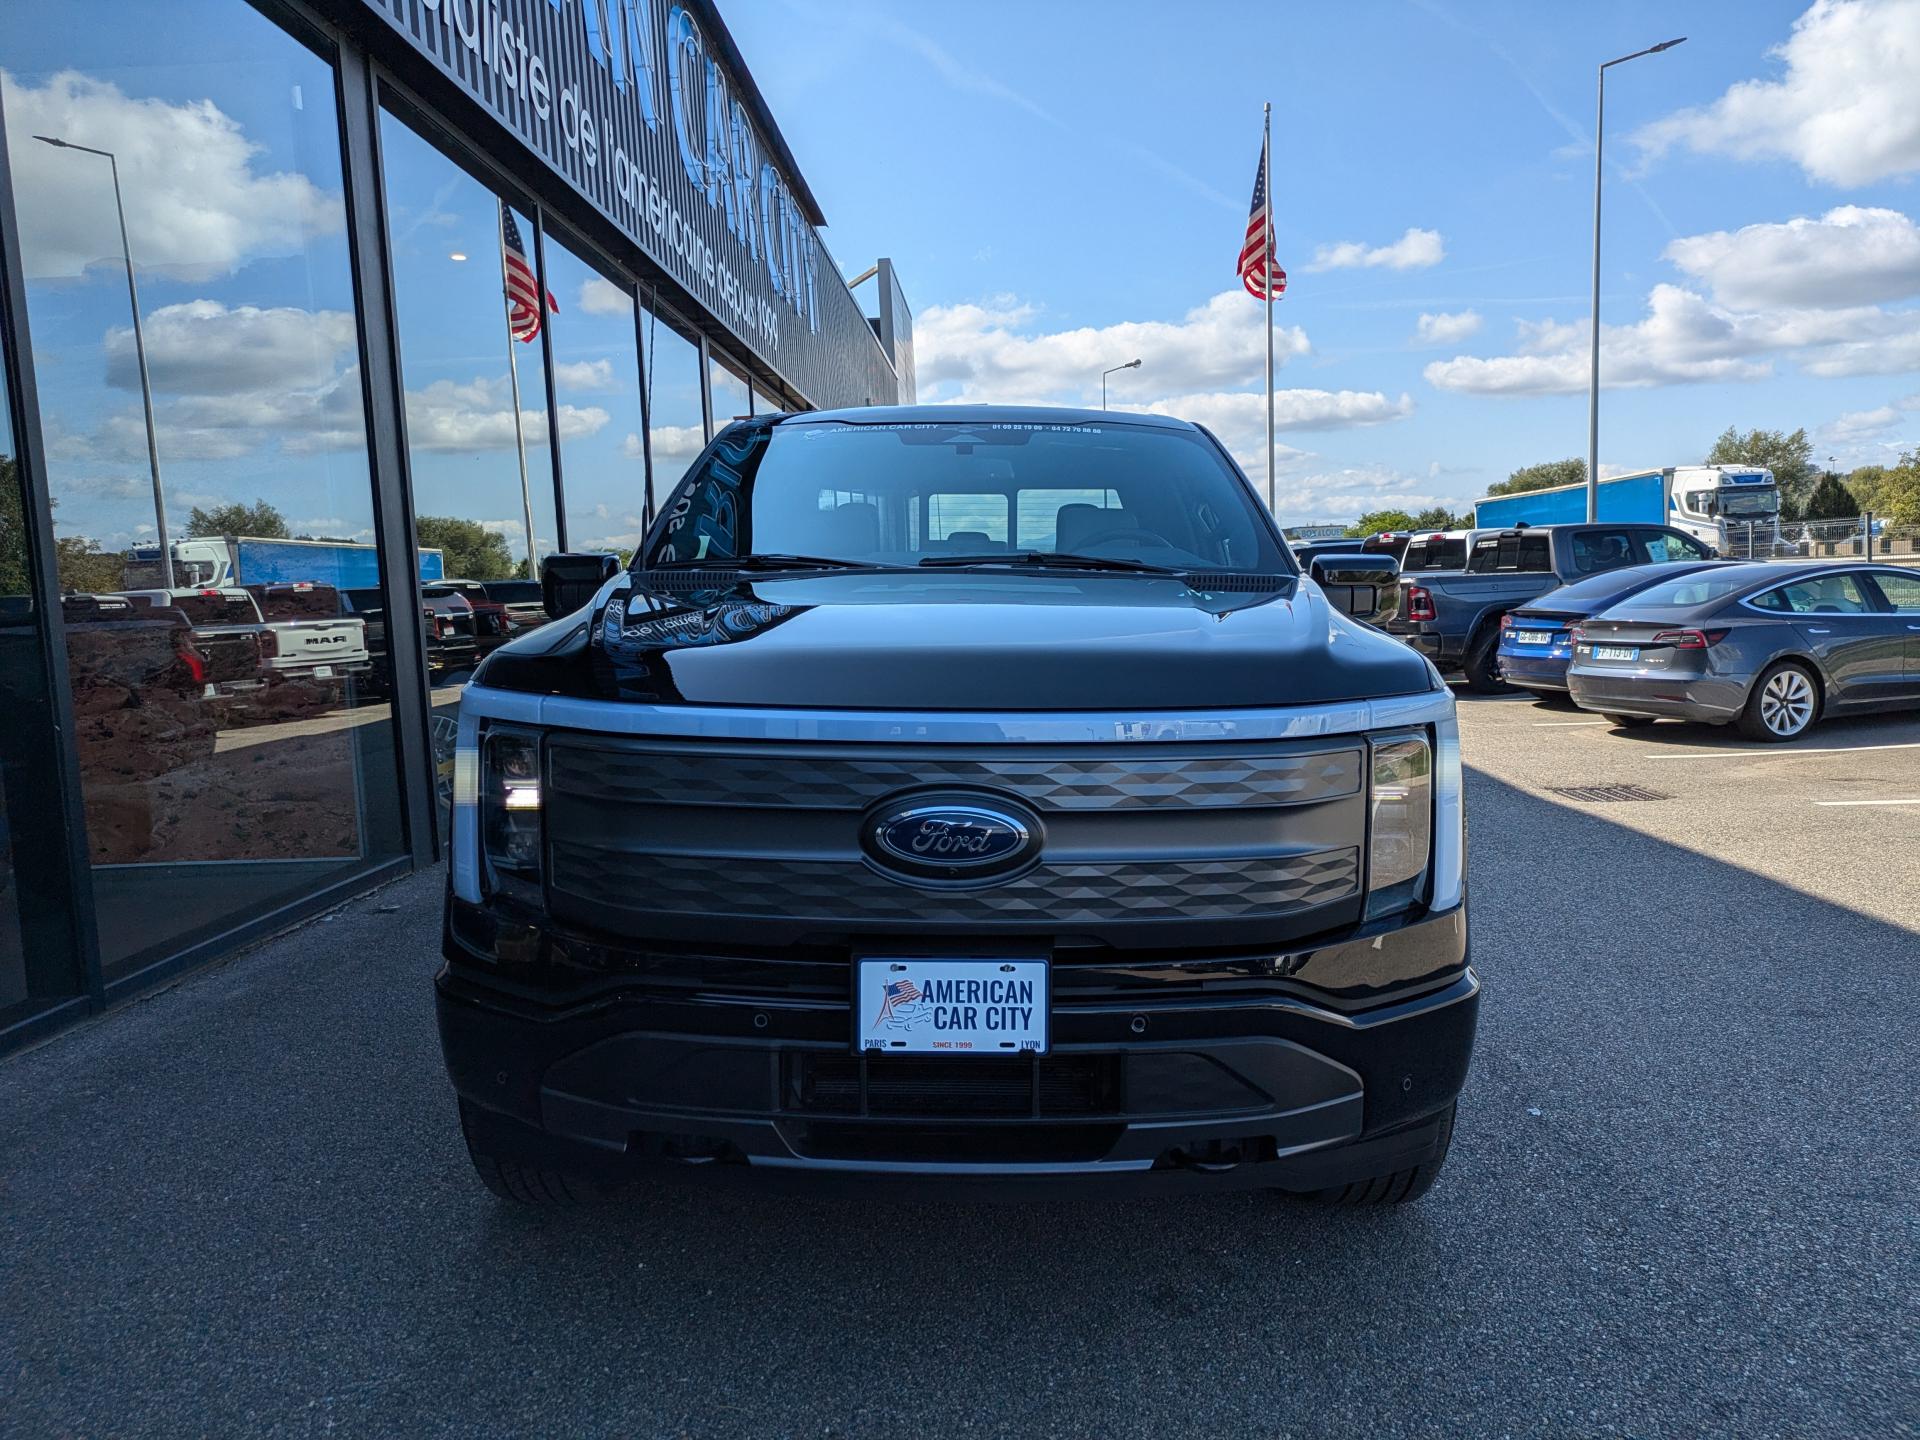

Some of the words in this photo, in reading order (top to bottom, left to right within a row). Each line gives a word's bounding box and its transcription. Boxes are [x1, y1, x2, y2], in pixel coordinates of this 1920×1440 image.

[668, 5, 765, 265] CAR
[422, 0, 551, 121] aliste
[560, 83, 597, 168] de
[717, 255, 756, 330] depuis
[757, 295, 779, 351] 1999
[829, 424, 887, 433] AMERICAN
[911, 819, 993, 853] Ford
[921, 979, 1033, 1004] AMERICAN
[934, 1006, 978, 1030] CAR
[985, 1006, 1033, 1030] CITY
[864, 1038, 887, 1048] PARIS
[932, 1041, 953, 1049] SINCE
[955, 1041, 973, 1049] 1999
[1020, 1040, 1041, 1049] LYON
